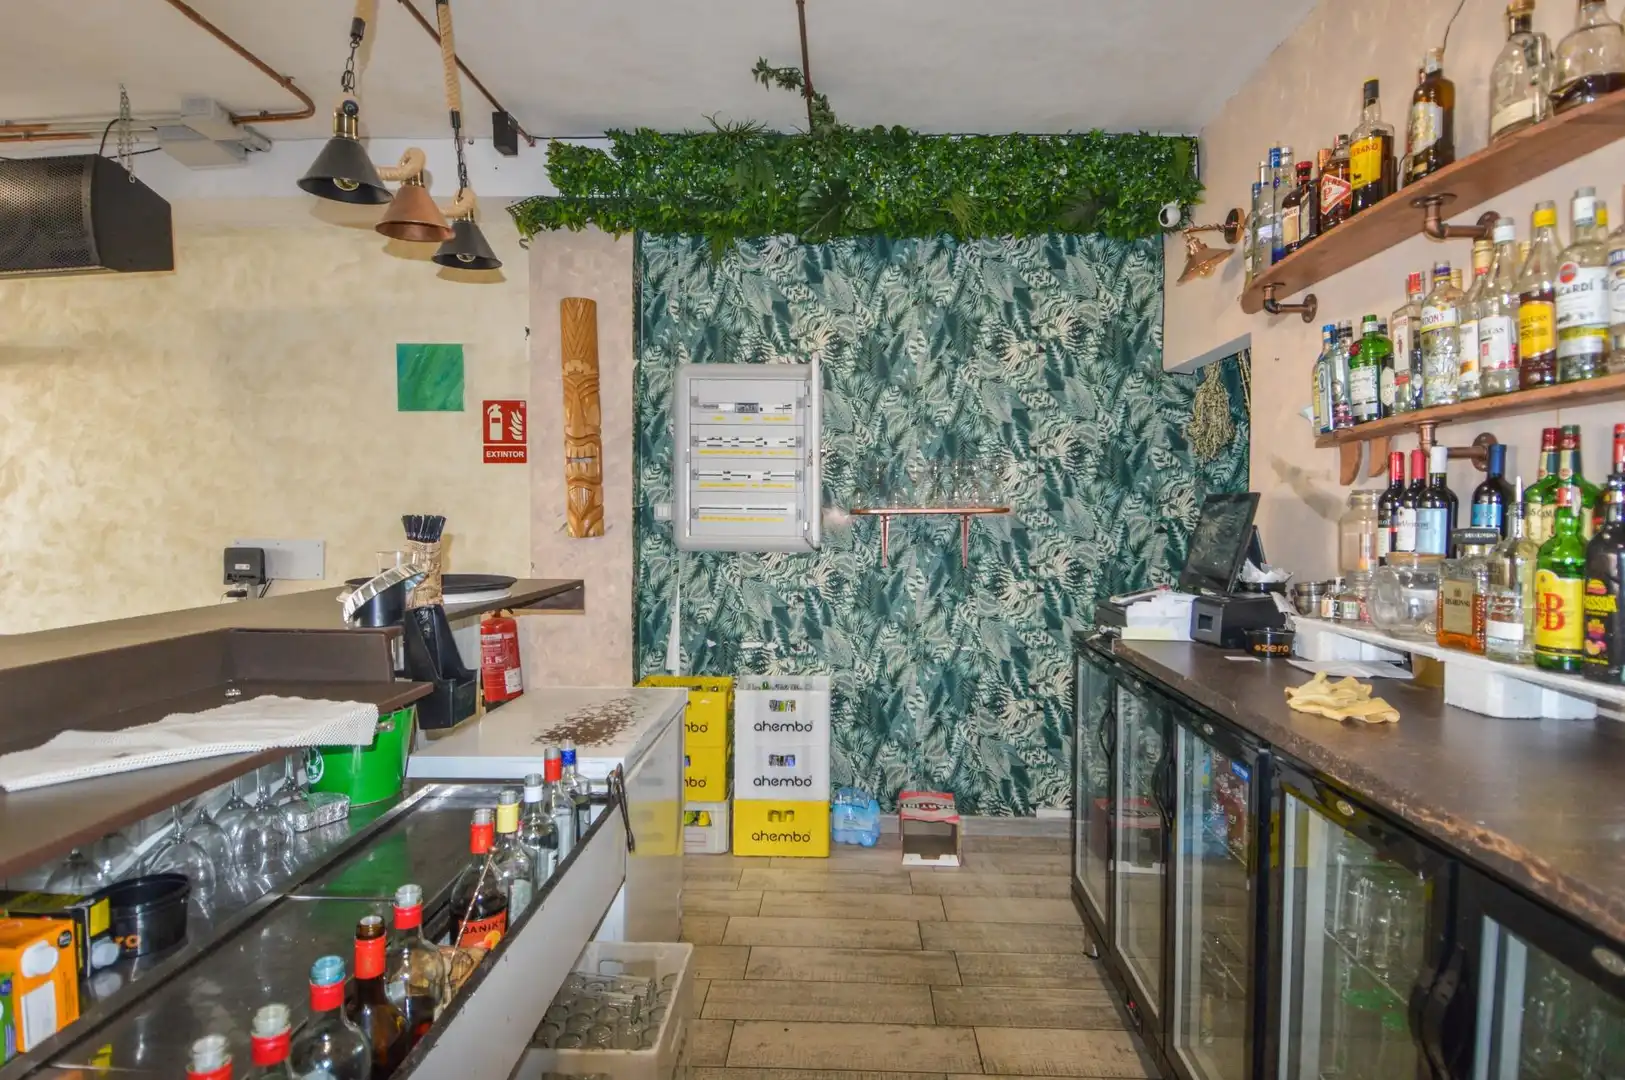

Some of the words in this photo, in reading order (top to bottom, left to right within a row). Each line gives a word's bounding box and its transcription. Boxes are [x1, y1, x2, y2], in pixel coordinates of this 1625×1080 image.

[753, 720, 813, 733] ahembo
[753, 775, 812, 788] ahembo
[752, 830, 810, 843] ahembo
